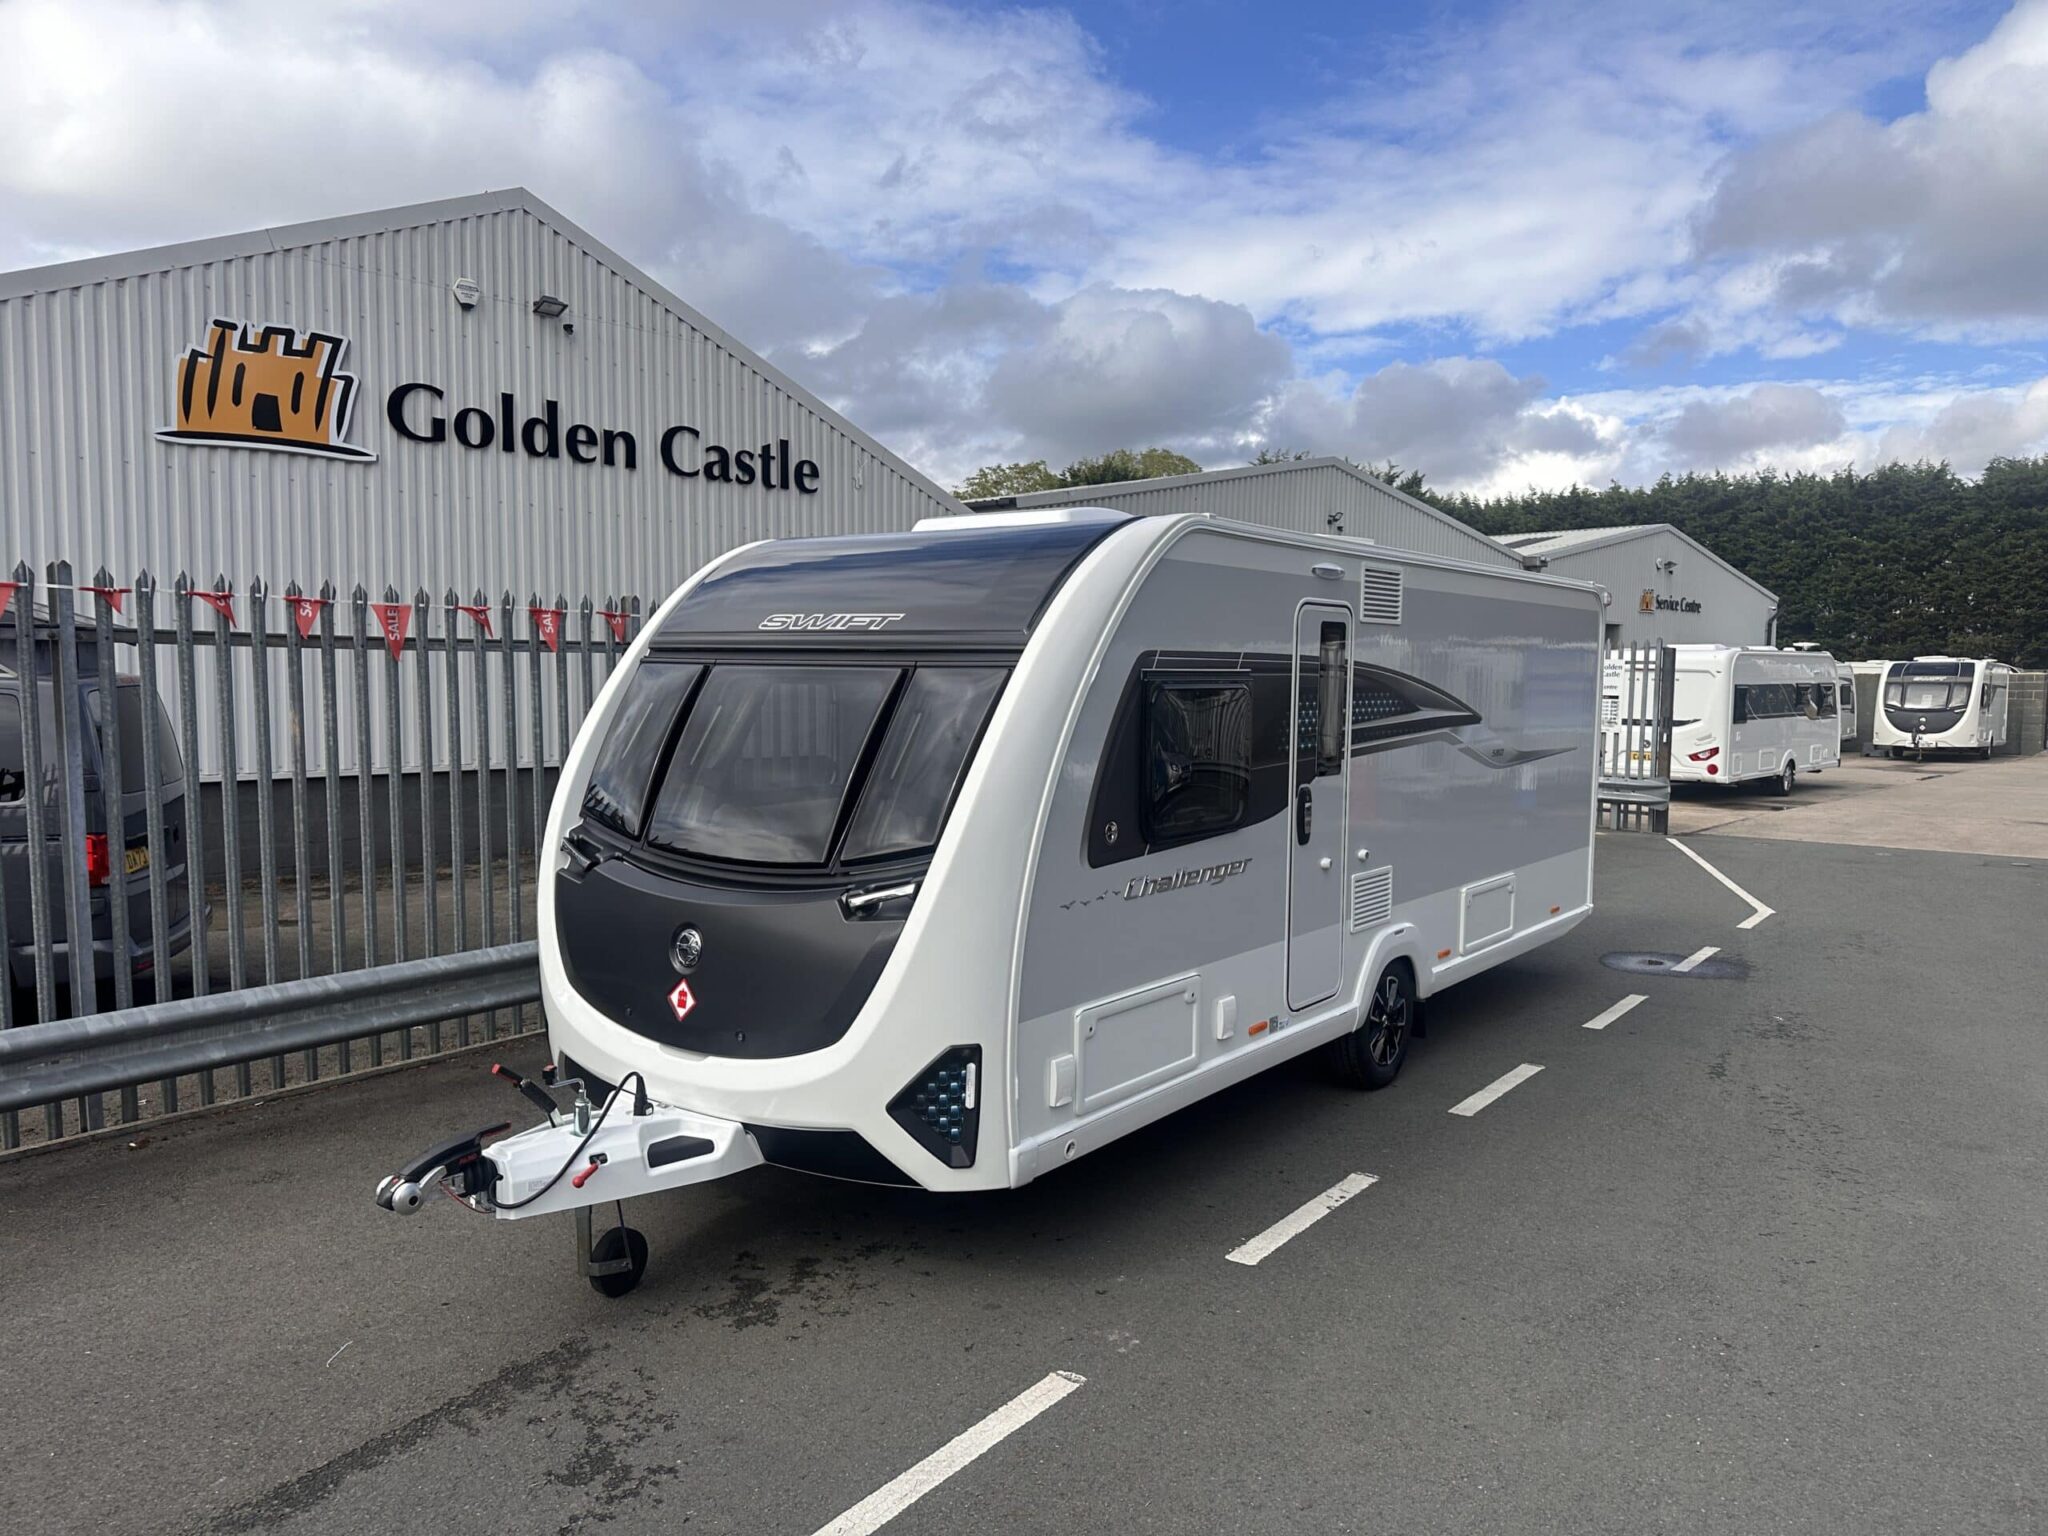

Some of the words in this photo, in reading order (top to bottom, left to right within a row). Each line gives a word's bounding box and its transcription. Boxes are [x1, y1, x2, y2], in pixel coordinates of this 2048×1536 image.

[387, 383, 637, 469] Golden
[660, 425, 820, 494] Castle
[1655, 594, 1680, 611] Service
[1680, 597, 1702, 614] Centre
[387, 608, 400, 641] SALE
[542, 608, 554, 634] SAL
[758, 613, 906, 631] SWIFT
[1123, 857, 1254, 901] Challenger
